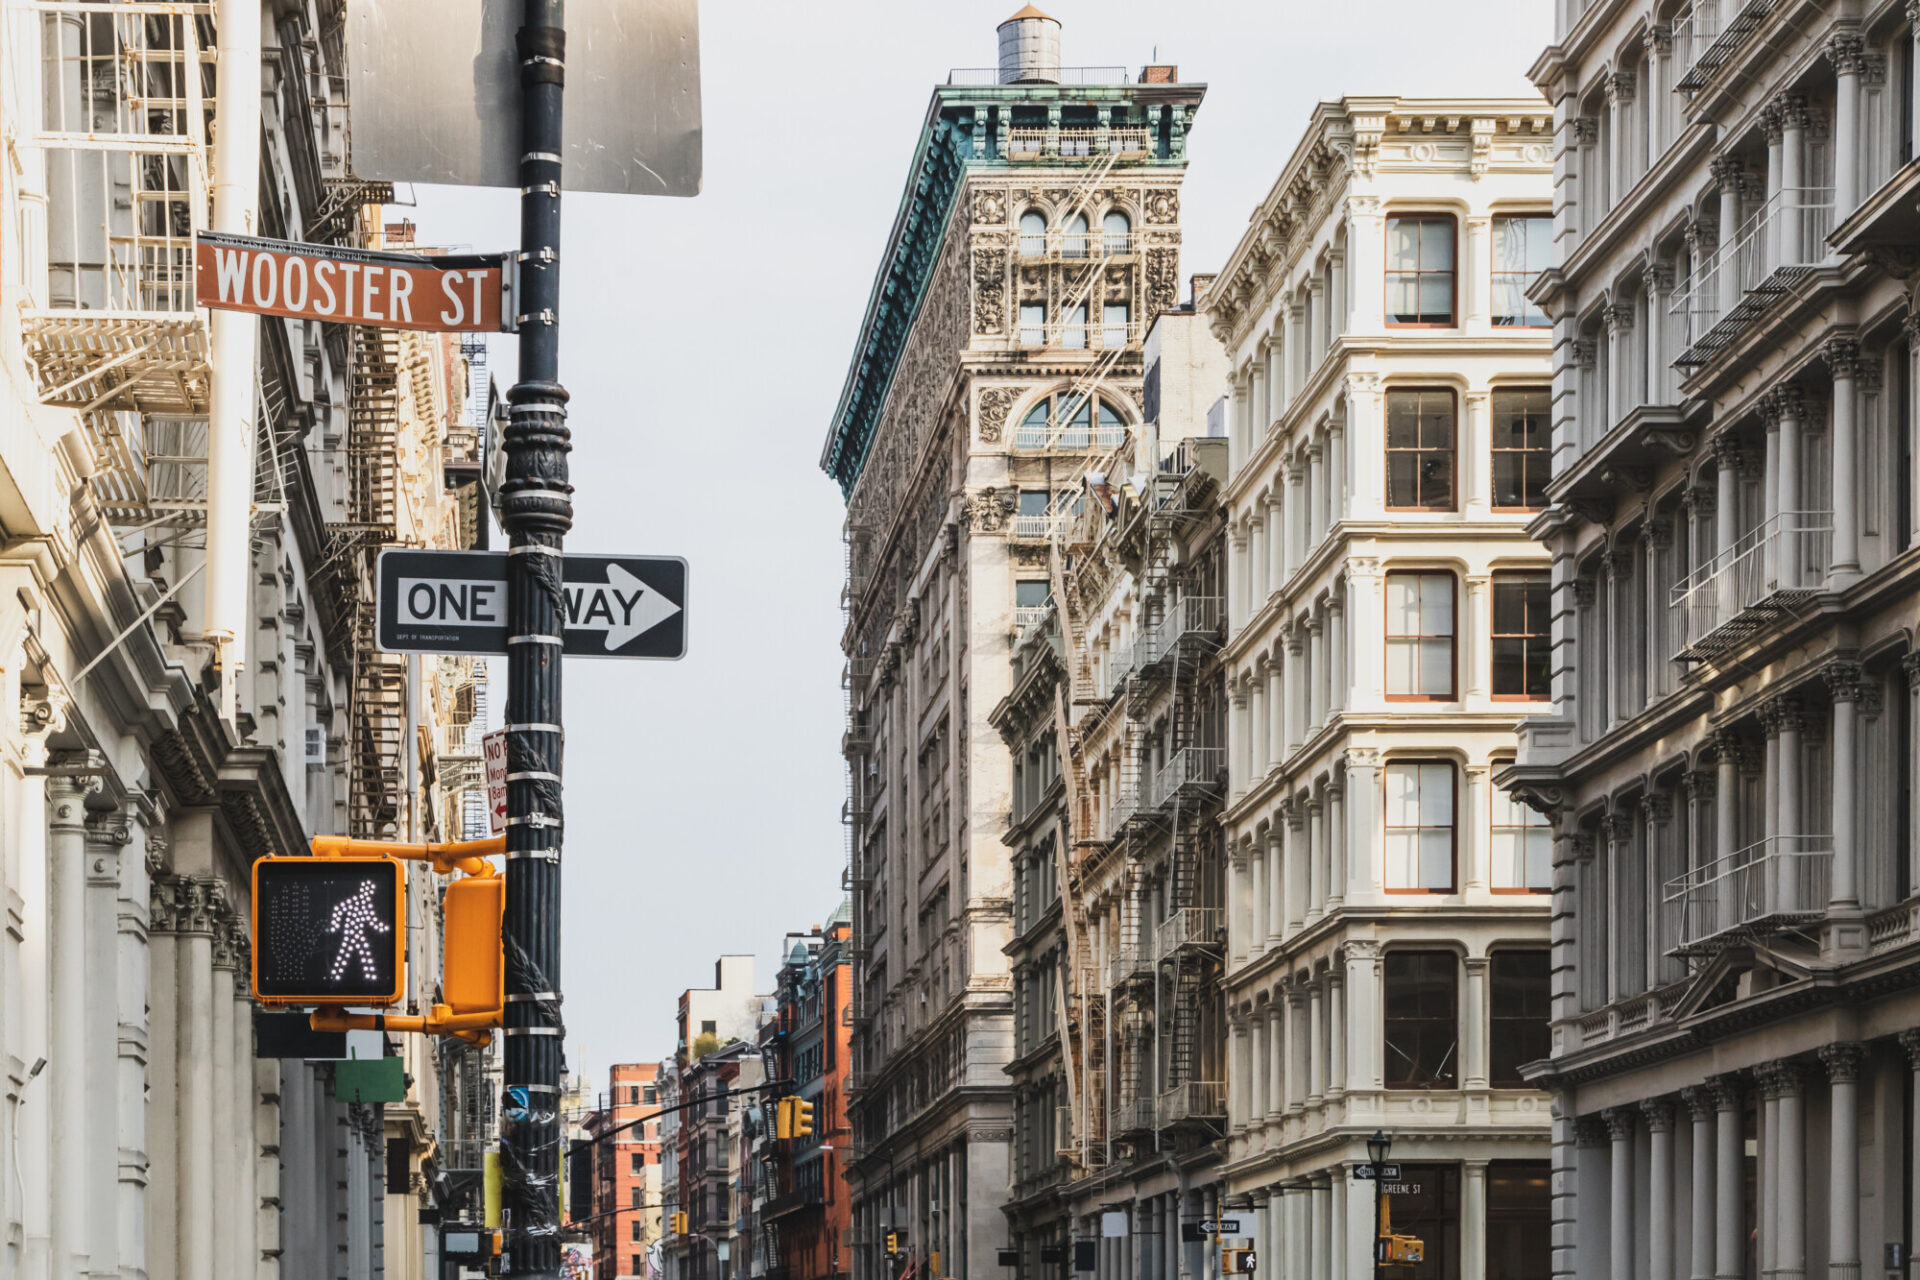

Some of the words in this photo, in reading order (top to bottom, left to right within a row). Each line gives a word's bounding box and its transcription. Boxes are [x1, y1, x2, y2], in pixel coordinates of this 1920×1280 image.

[288, 243, 330, 258] HISTORIC
[332, 249, 371, 262] DISTRICT
[215, 247, 414, 323] WOOSTER
[440, 270, 489, 327] ST
[407, 582, 496, 622] ONE
[420, 634, 460, 642] TRANSPORTATION
[487, 742, 501, 761] NO
[1383, 1184, 1410, 1194] GREENE
[1412, 1184, 1421, 1194] ST
